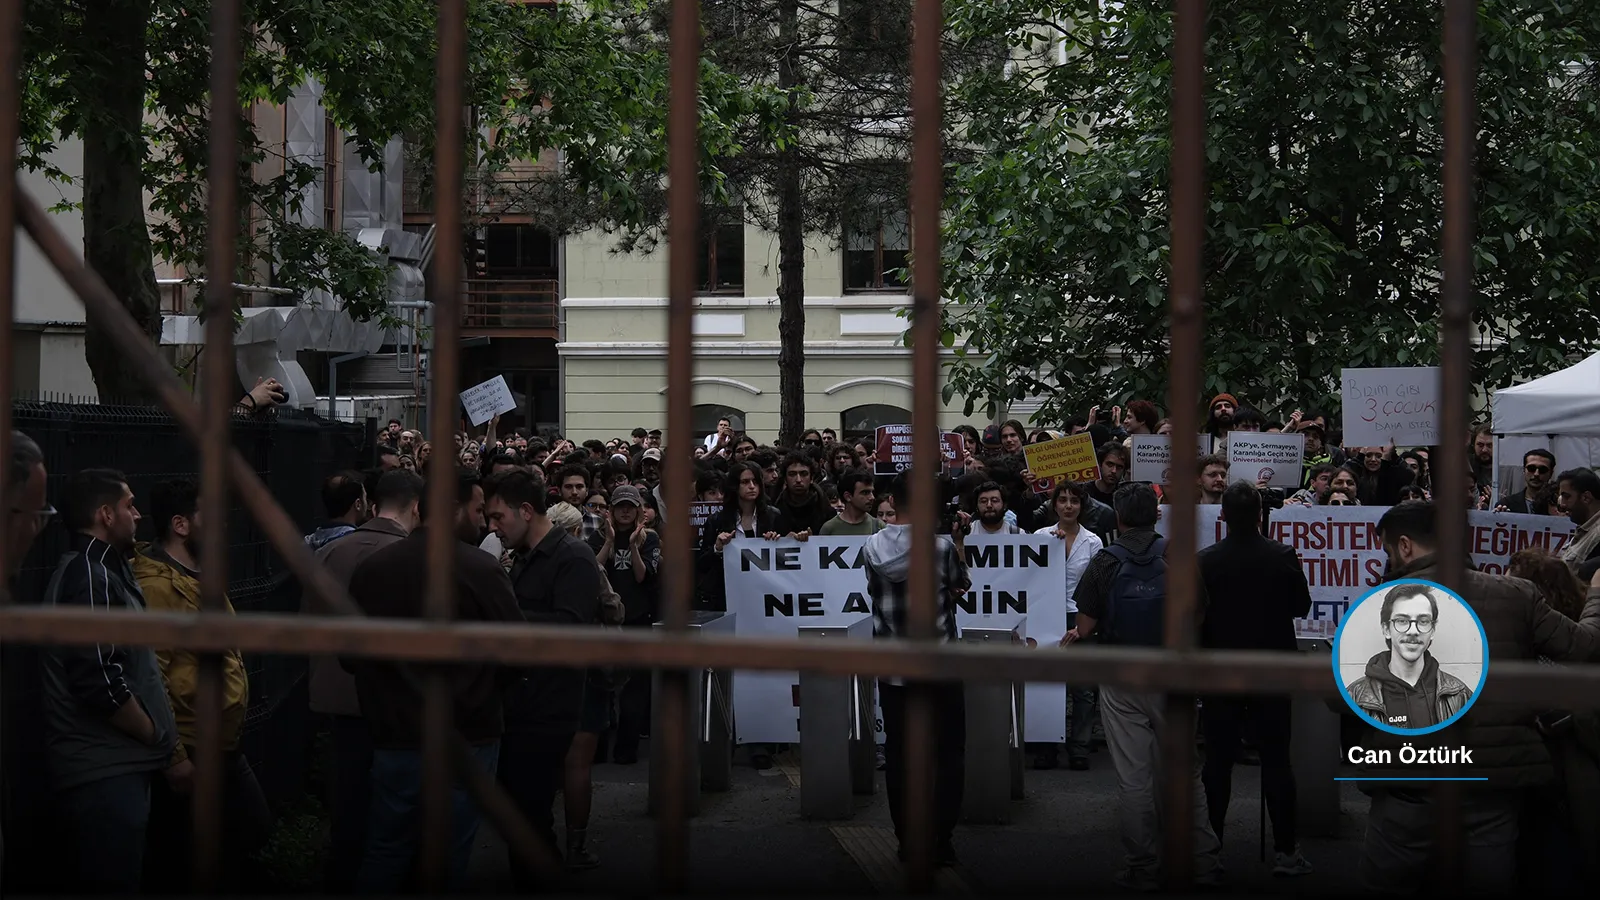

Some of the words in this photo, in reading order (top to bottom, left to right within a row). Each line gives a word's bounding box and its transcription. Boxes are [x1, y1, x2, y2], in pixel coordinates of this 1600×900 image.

[1360, 398, 1377, 422] 3
[1382, 400, 1437, 416] ÇOCUK
[885, 424, 914, 435] KAMPÜSL
[1375, 421, 1403, 431] DAHA
[1025, 445, 1043, 456] BİLGİ
[1261, 443, 1298, 451] Sermayeye,
[1036, 447, 1084, 463] ÖĞRENCİLERİ
[1267, 450, 1284, 458] Geçit
[1032, 463, 1058, 473] YALNIZ
[741, 547, 801, 572] NE
[764, 592, 825, 617] NE
